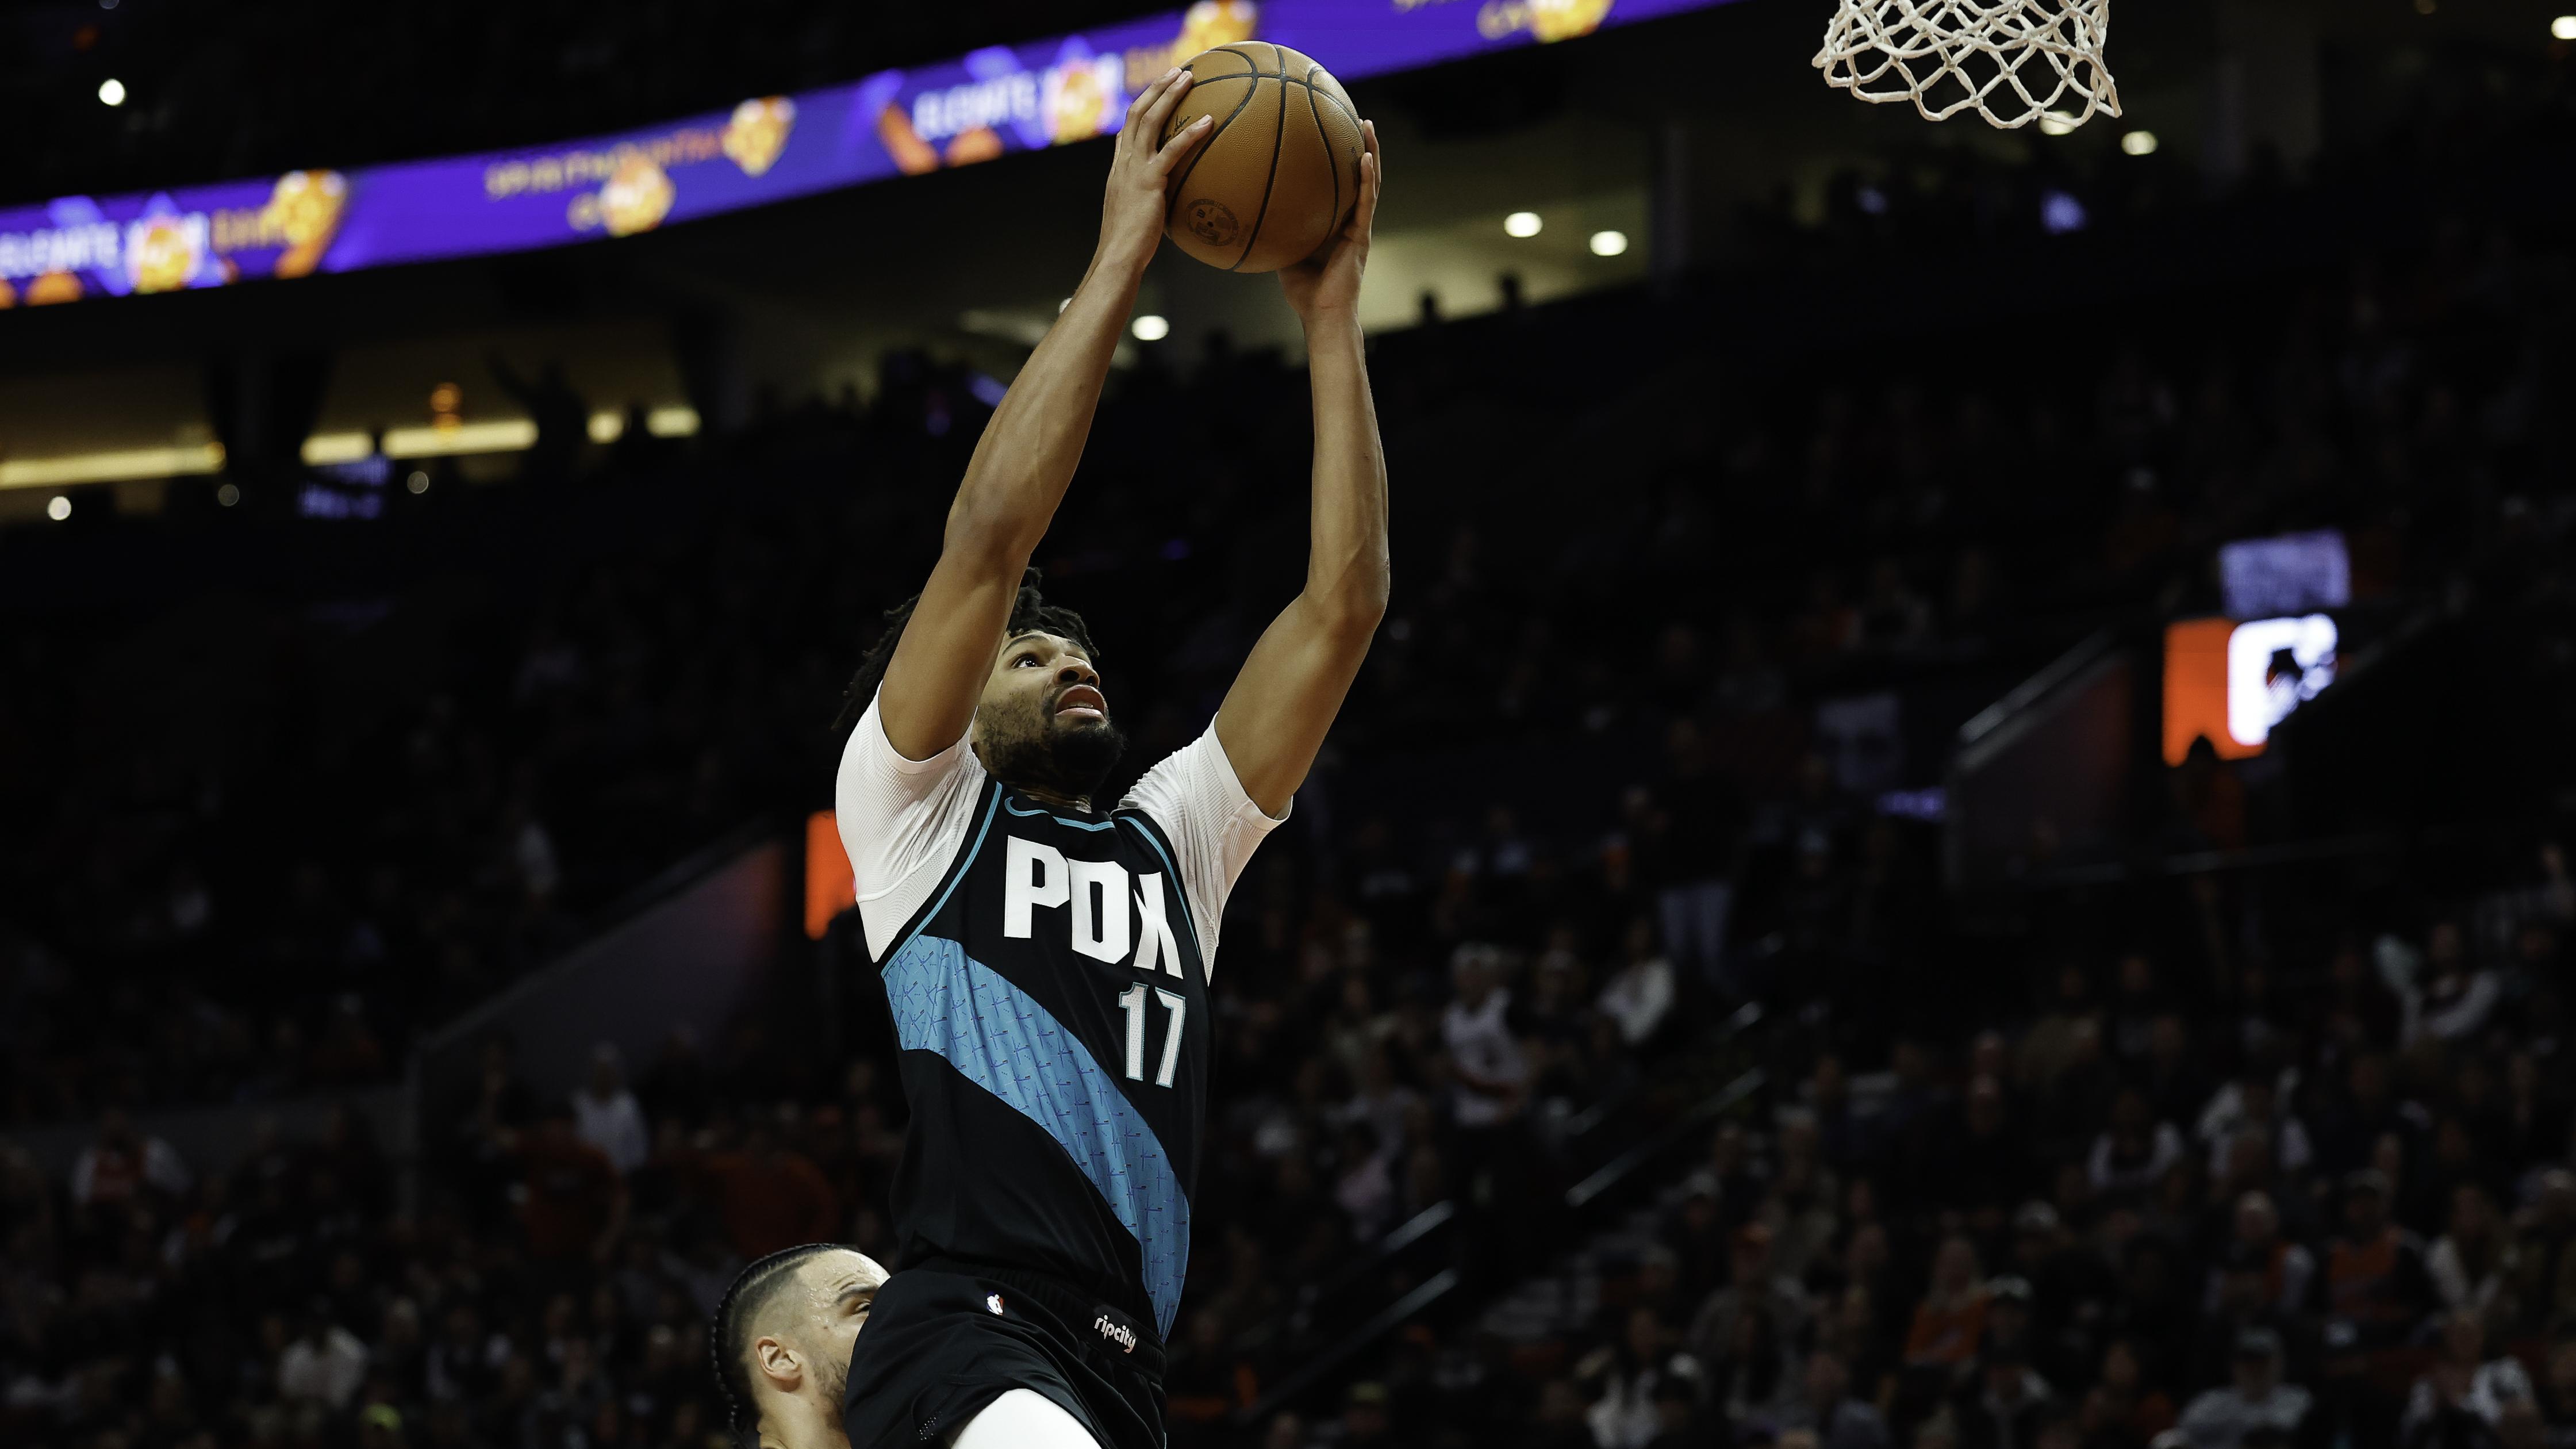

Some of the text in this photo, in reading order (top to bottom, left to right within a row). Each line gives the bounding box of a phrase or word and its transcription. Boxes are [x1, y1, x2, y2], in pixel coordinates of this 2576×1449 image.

[1004, 835, 1184, 979] PDX
[1119, 982, 1186, 1088] 17
[1094, 1314, 1136, 1354] ripcity
